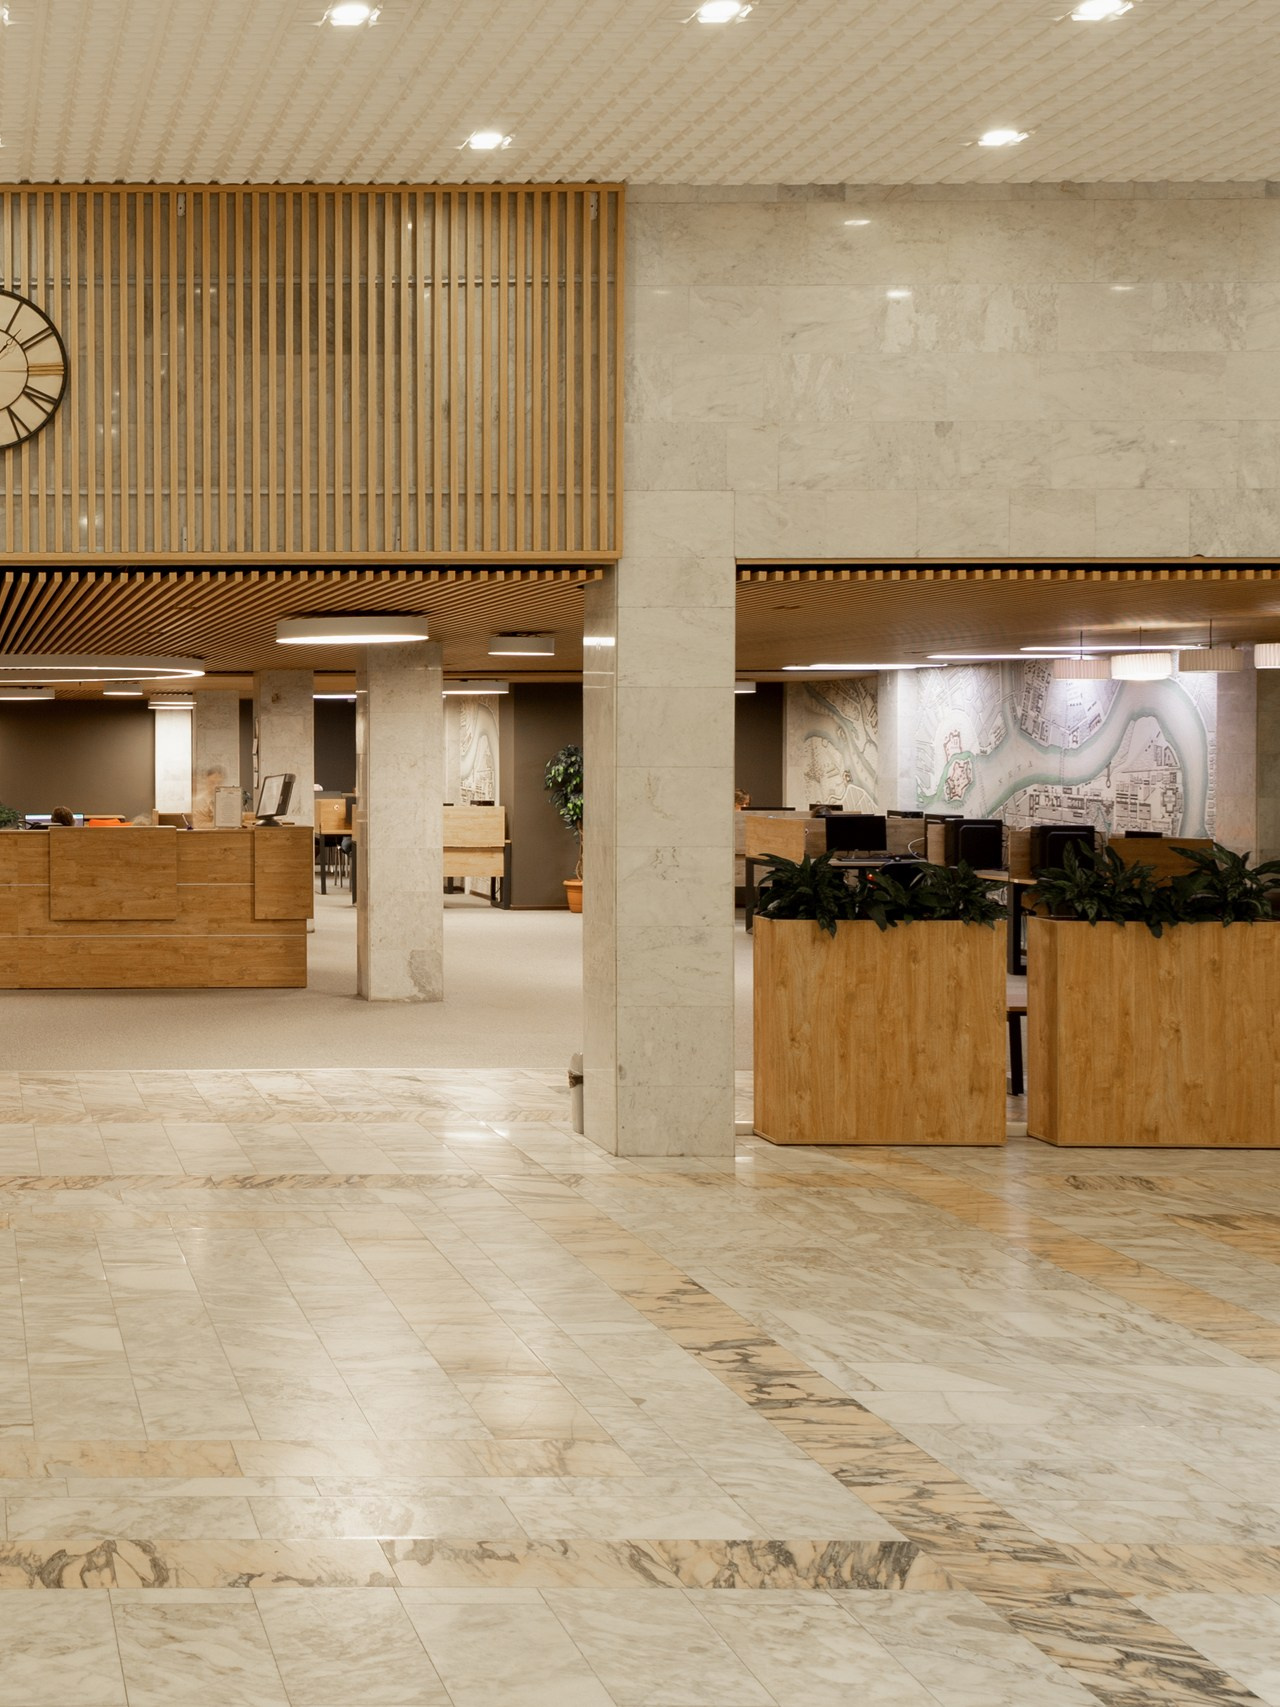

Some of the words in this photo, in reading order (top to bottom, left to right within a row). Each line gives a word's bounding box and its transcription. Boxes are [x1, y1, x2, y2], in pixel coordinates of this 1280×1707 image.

[5, 302, 24, 333] I
[19, 326, 54, 352] II
[28, 362, 64, 375] III
[22, 384, 58, 416] IV
[6, 406, 33, 440] V
